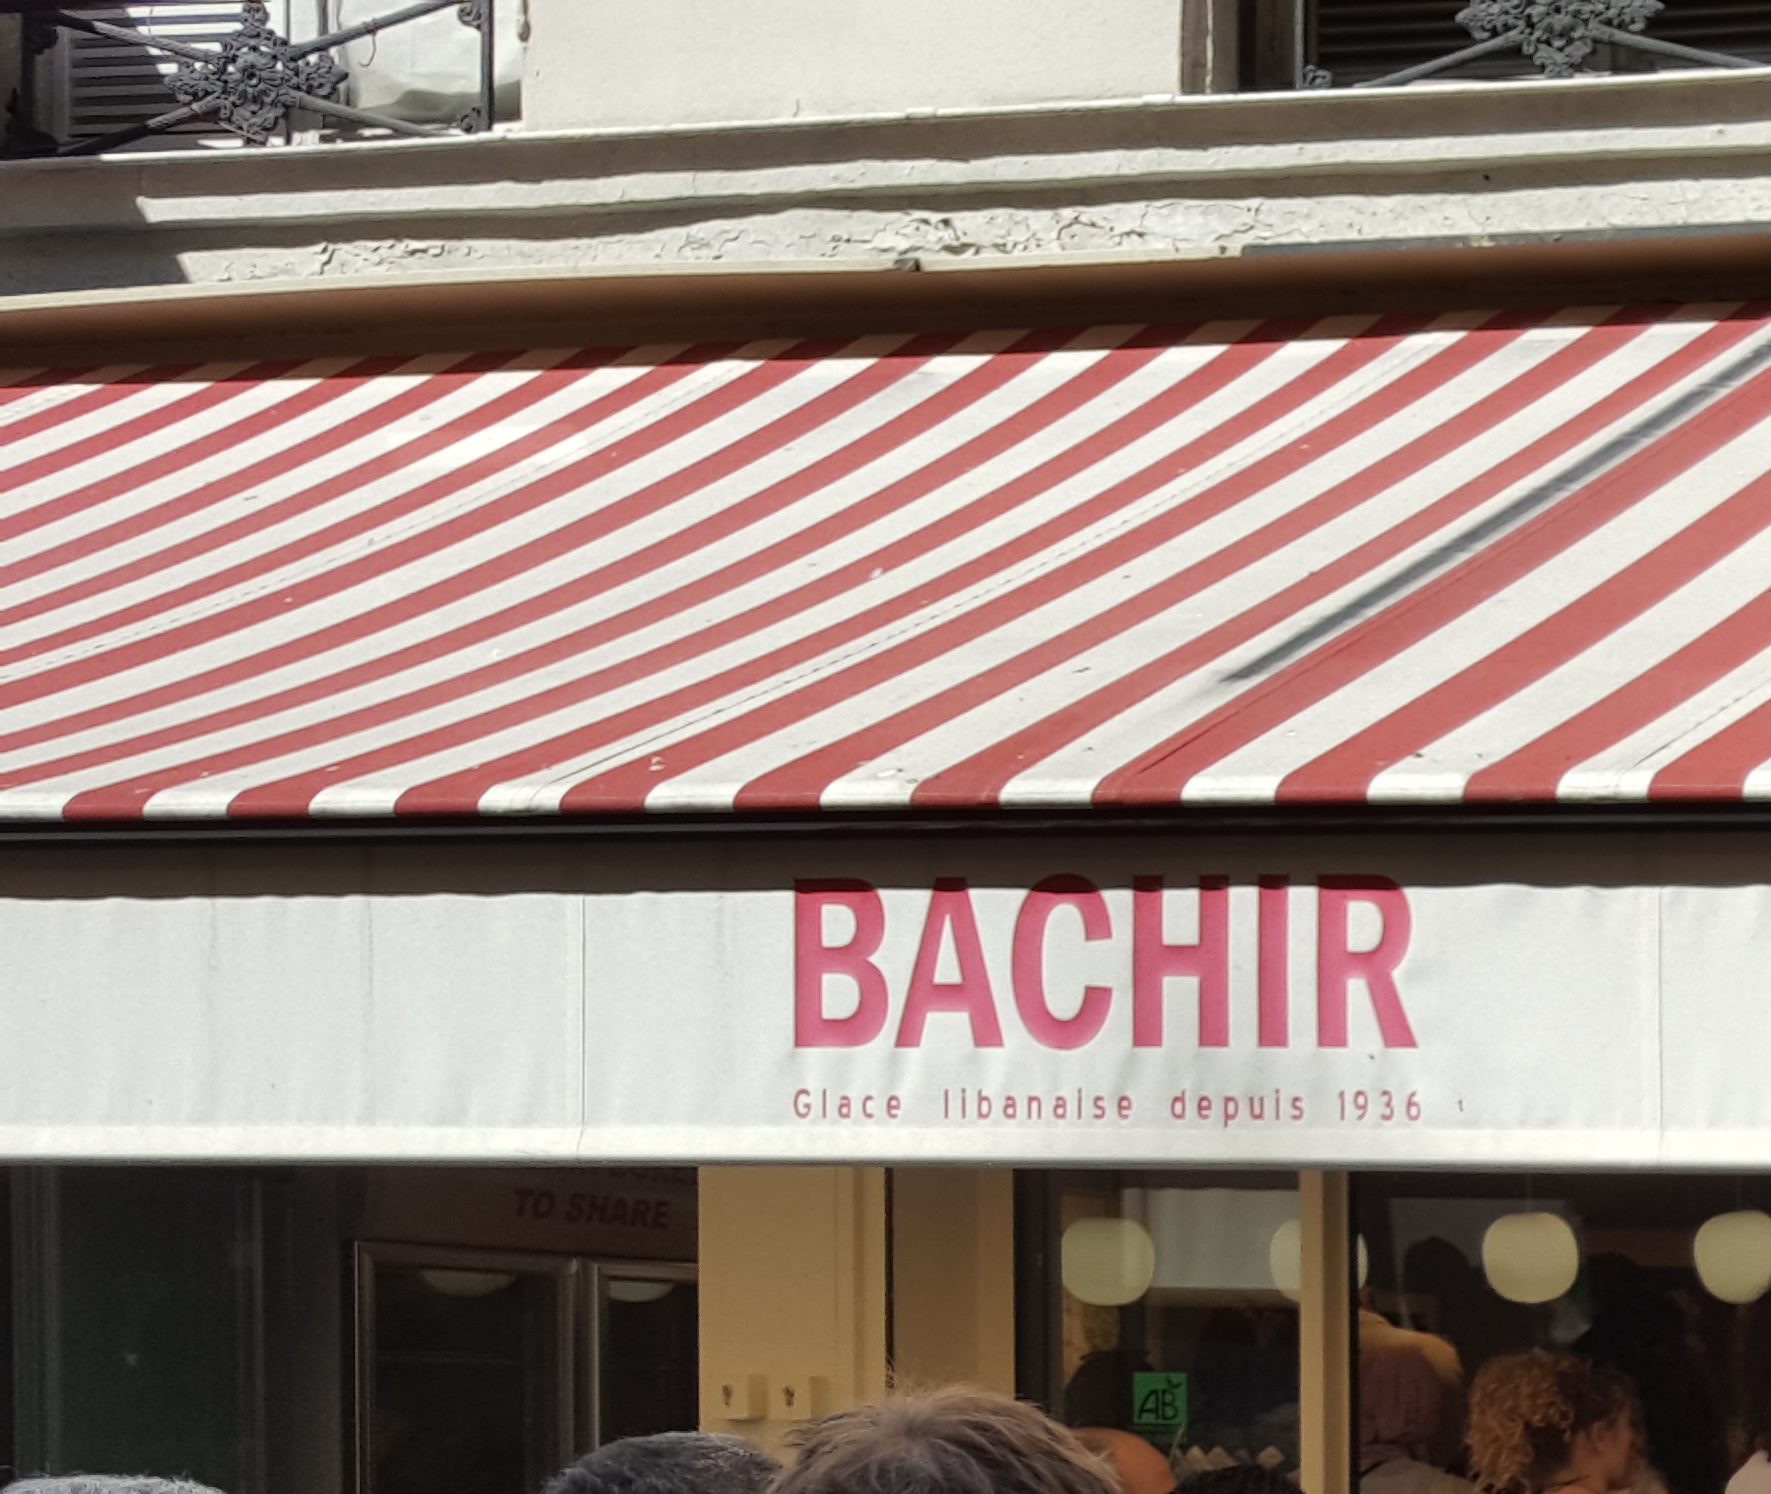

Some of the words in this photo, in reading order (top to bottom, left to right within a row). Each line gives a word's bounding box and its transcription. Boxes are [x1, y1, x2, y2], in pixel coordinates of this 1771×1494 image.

[794, 873, 1418, 1051] BACHIR
[793, 1088, 903, 1121] Glace
[943, 1088, 1134, 1121] libanaise
[1170, 1088, 1306, 1128] depuis
[1337, 1088, 1423, 1121] 1936
[514, 1188, 556, 1220] TO
[565, 1192, 671, 1230] SHARE
[1138, 1388, 1178, 1421] AB
